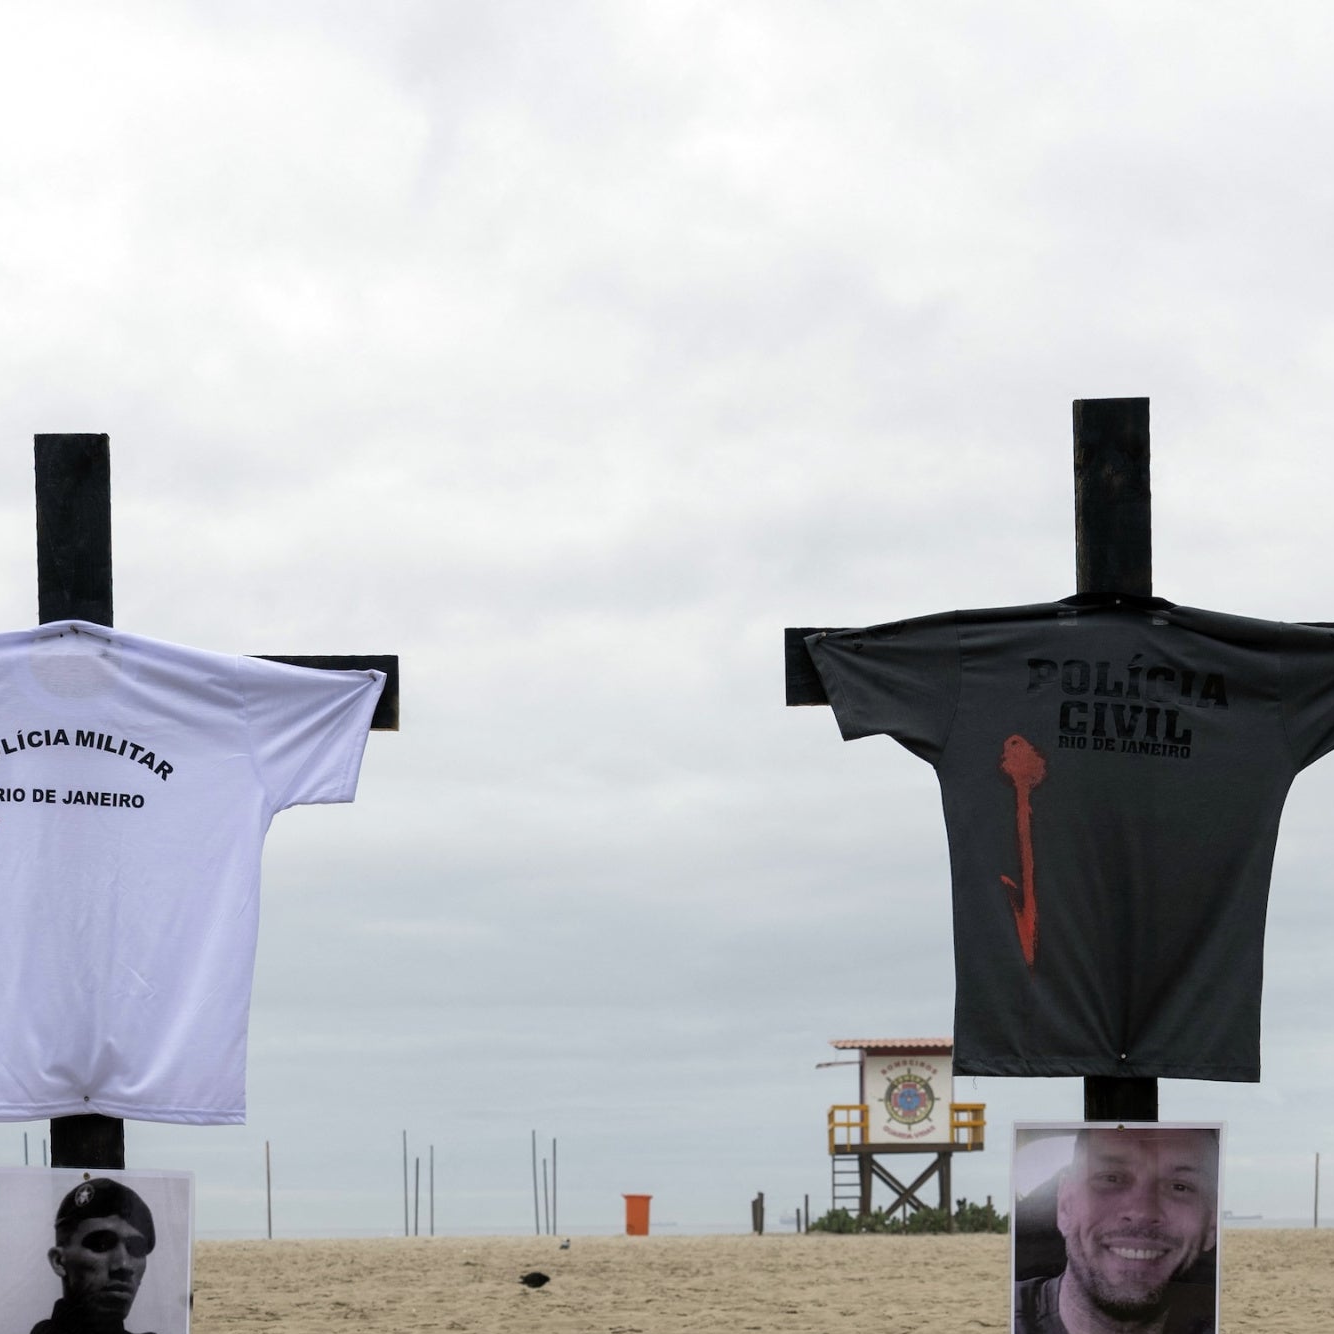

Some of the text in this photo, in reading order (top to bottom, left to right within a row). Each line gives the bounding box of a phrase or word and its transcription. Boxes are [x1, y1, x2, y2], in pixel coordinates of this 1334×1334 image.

[1027, 654, 1229, 710] POLÍCIA
[1059, 701, 1193, 745] CIVIL
[75, 730, 174, 781] MILITAR
[1058, 735, 1191, 759] RIO DE JANEIRO
[32, 788, 56, 803] DE
[62, 790, 145, 808] JANEIRO
